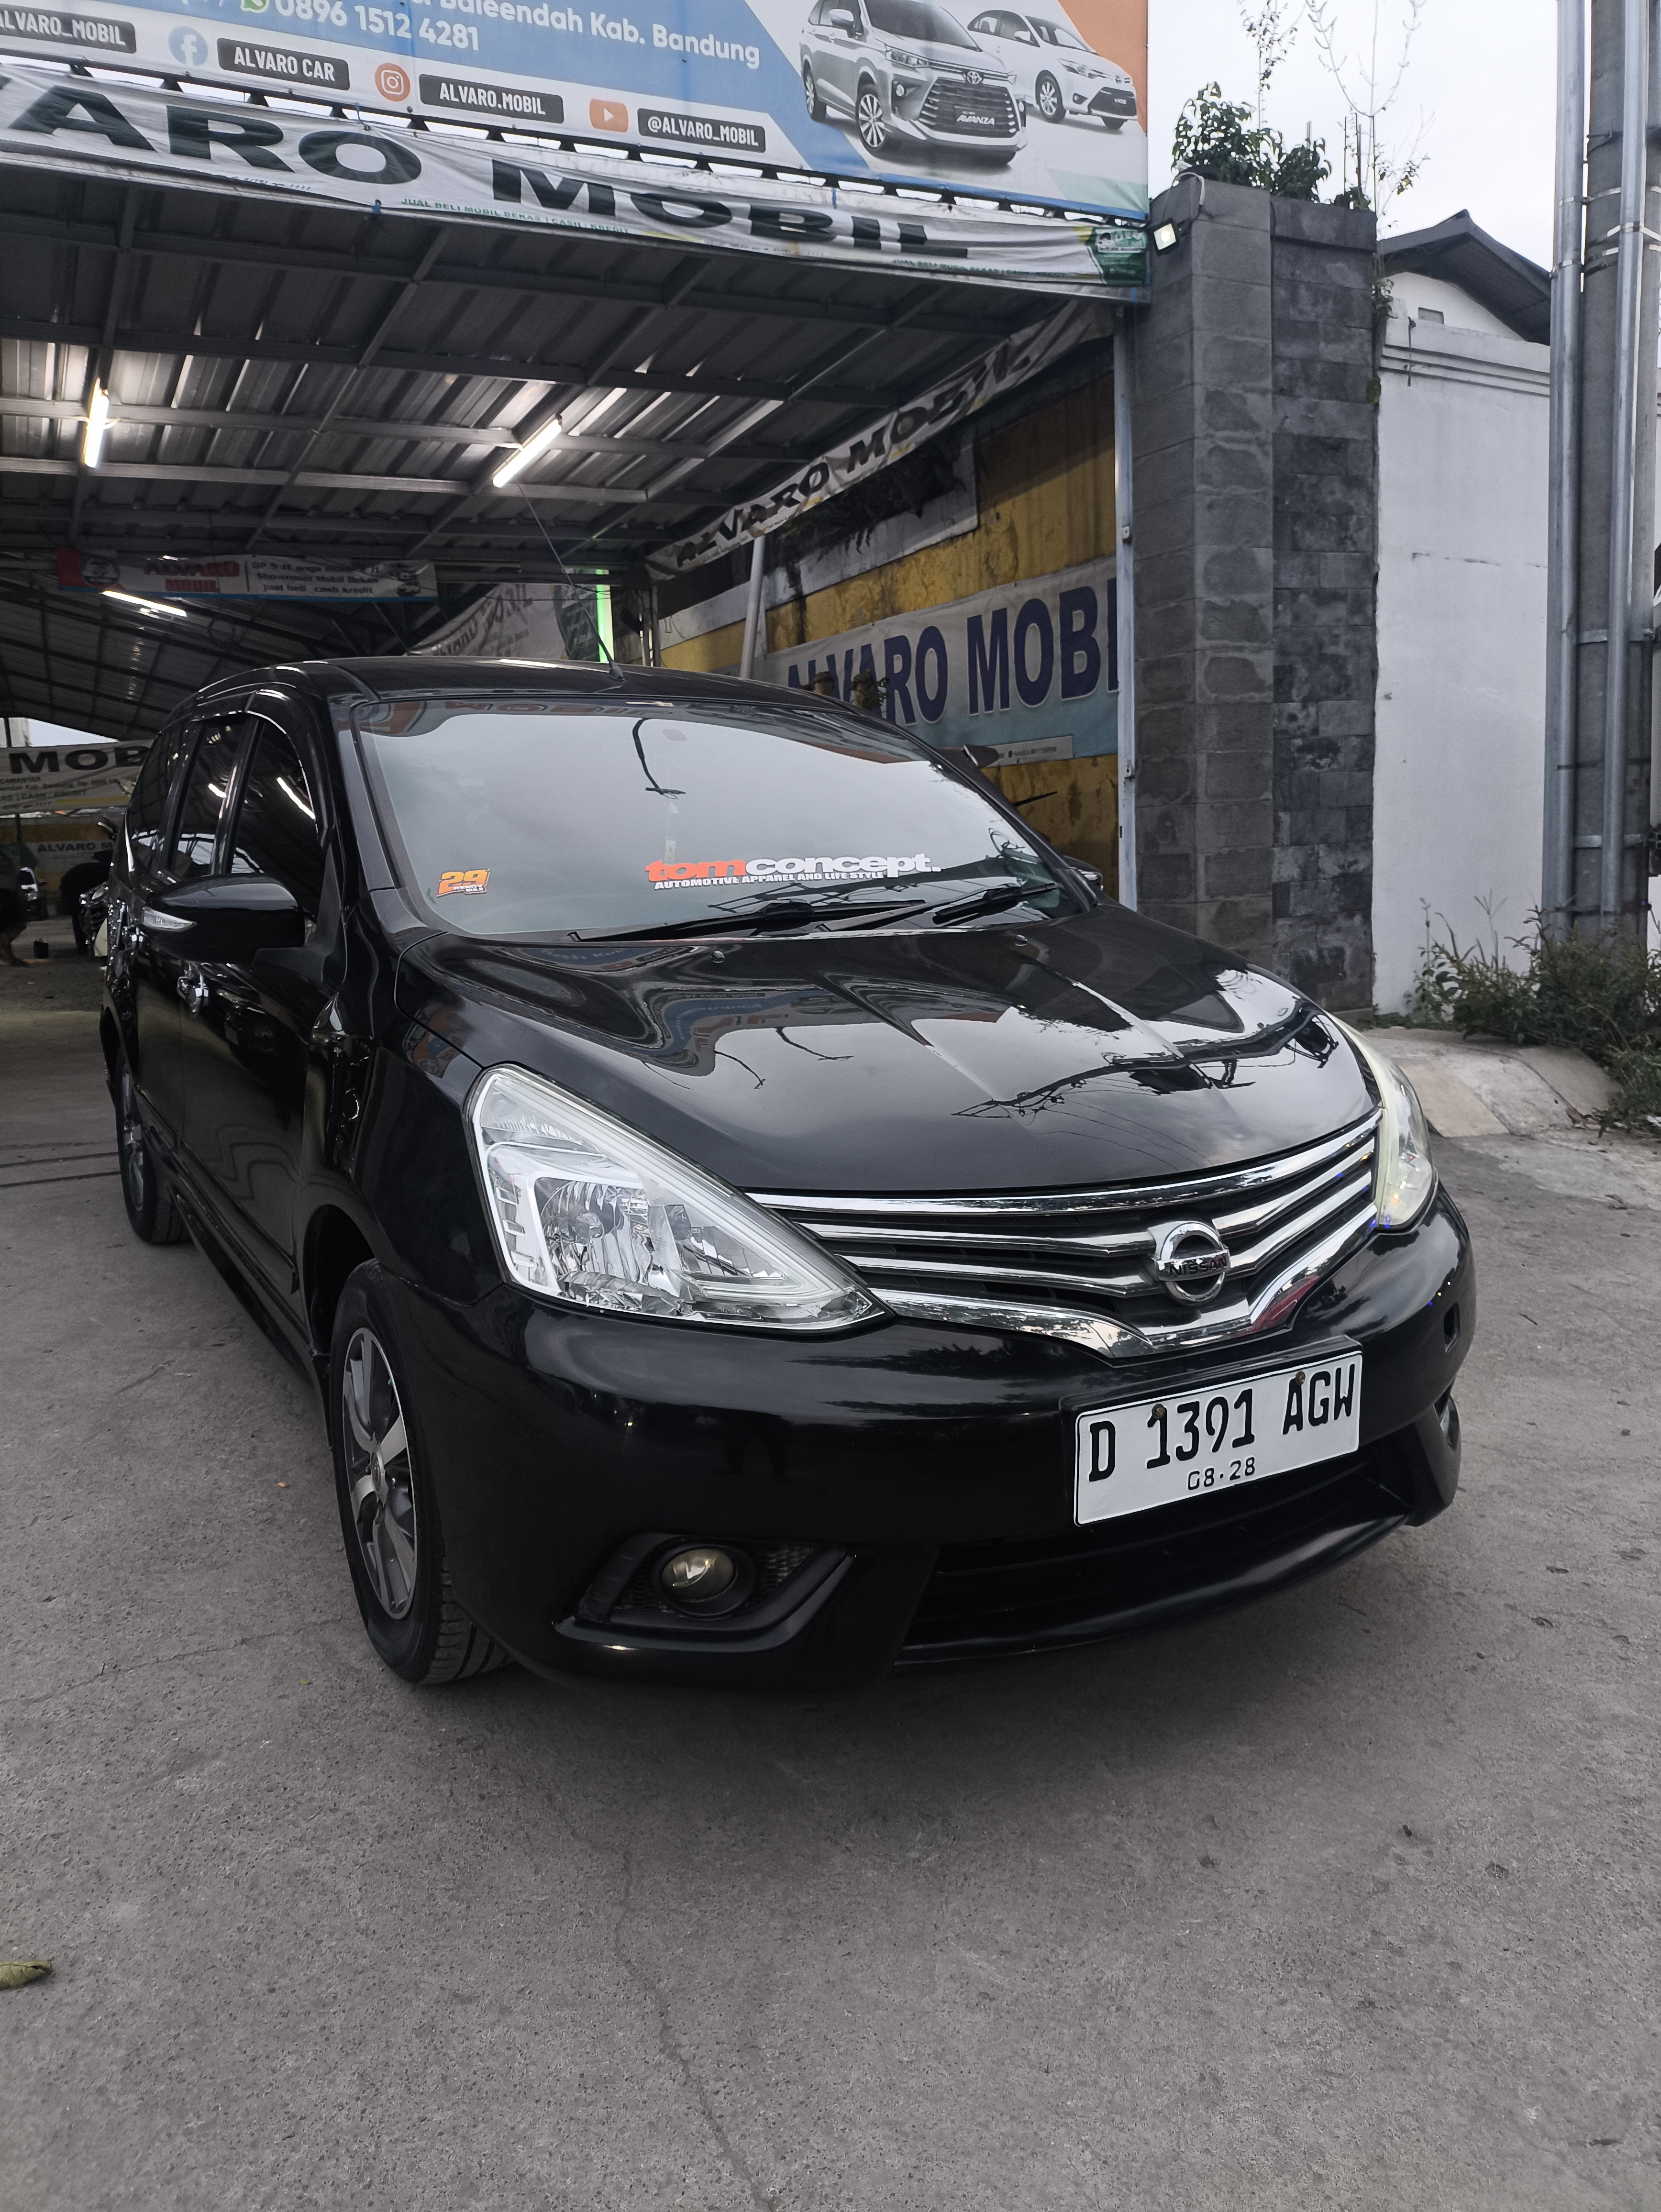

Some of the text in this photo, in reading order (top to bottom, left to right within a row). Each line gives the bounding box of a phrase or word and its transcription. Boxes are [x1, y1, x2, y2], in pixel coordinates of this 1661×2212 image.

[275, 0, 479, 51] 0896 1512 4281
[591, 12, 645, 44] Kab.
[653, 24, 760, 69] Bandung
[234, 46, 335, 82] ALVARO CAR
[439, 83, 546, 116] ALVARO.MOBIL
[648, 115, 759, 147] @ALVARO_MOBIL
[38, 842, 96, 852] ALVARO
[438, 870, 488, 894] 29
[742, 874, 796, 884] APPAREL
[797, 873, 822, 881] AND
[825, 872, 848, 880] LIFE
[1168, 1253, 1228, 1277] NISSAN
[1088, 1363, 1355, 1482] D 1391 AGW
